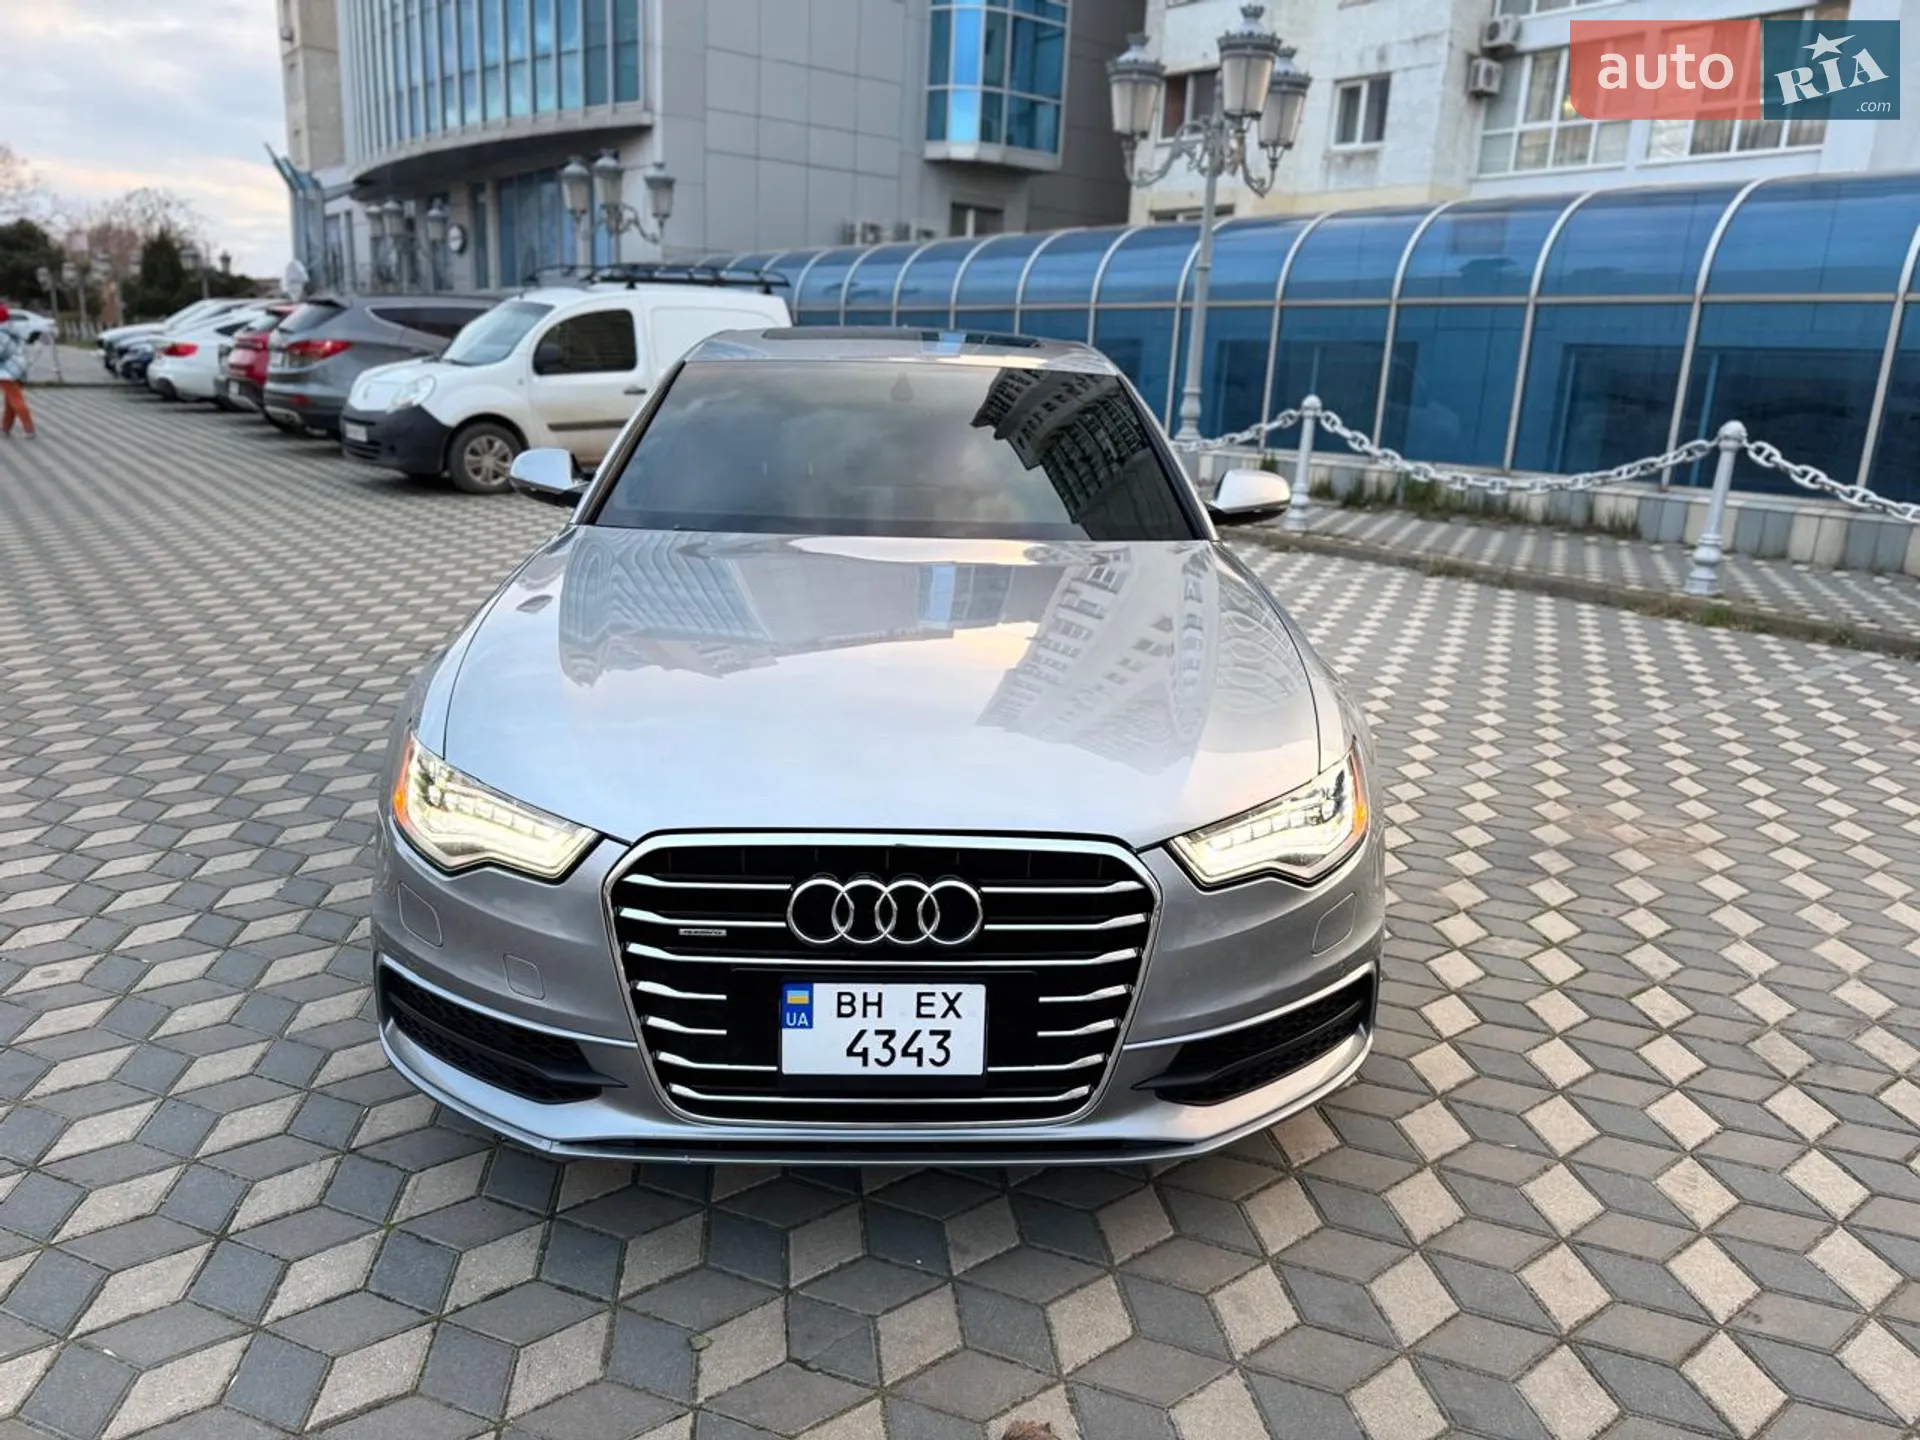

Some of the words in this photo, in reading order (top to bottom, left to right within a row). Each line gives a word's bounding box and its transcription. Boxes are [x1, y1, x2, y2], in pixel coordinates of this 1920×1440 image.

[836, 991, 883, 1018] BH
[915, 991, 963, 1019] EX
[786, 1012, 809, 1027] UA
[846, 1029, 952, 1067] 4343
